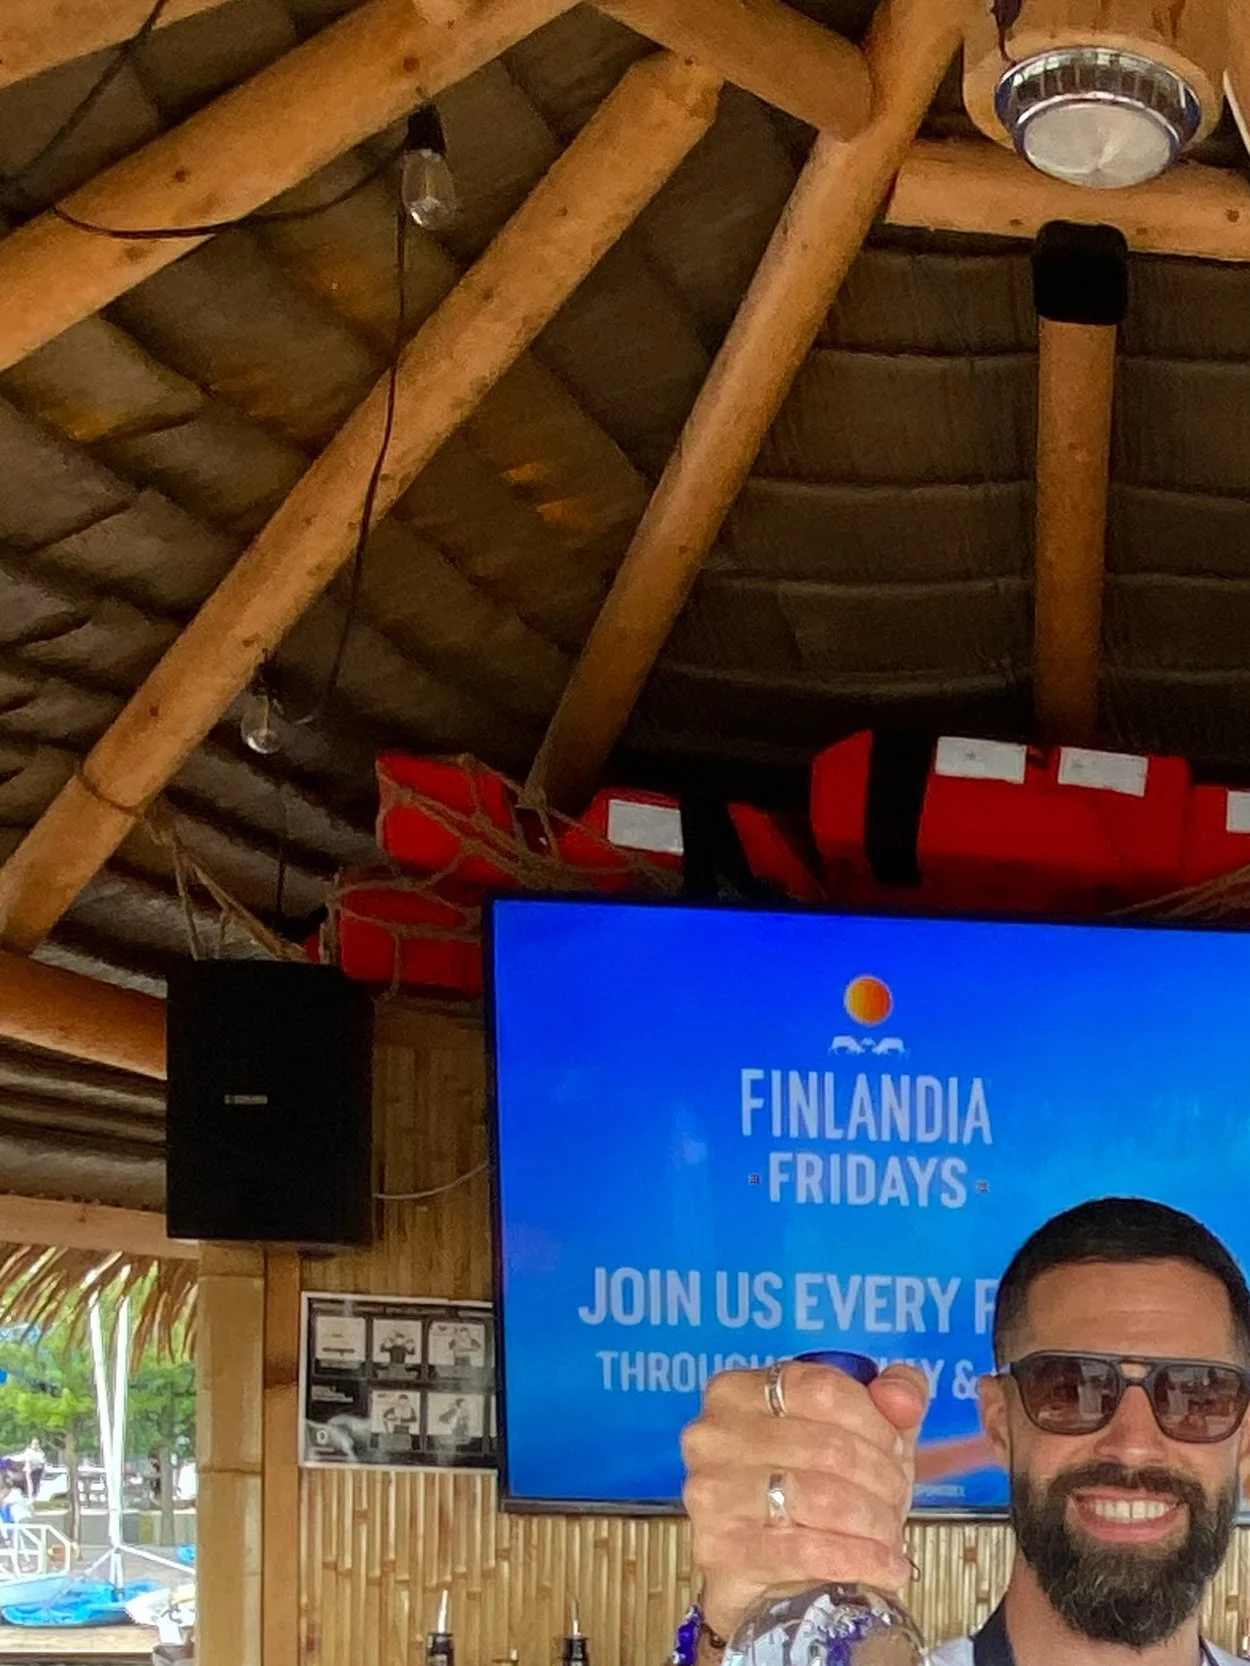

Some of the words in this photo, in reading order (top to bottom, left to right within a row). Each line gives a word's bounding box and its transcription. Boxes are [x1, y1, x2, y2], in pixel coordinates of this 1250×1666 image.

[740, 1068, 993, 1146] FINLANDIA
[769, 1152, 968, 1208] FRIDAYS
[578, 1266, 700, 1327] JOIN
[715, 1271, 784, 1329] US
[795, 1273, 962, 1334] EVERY
